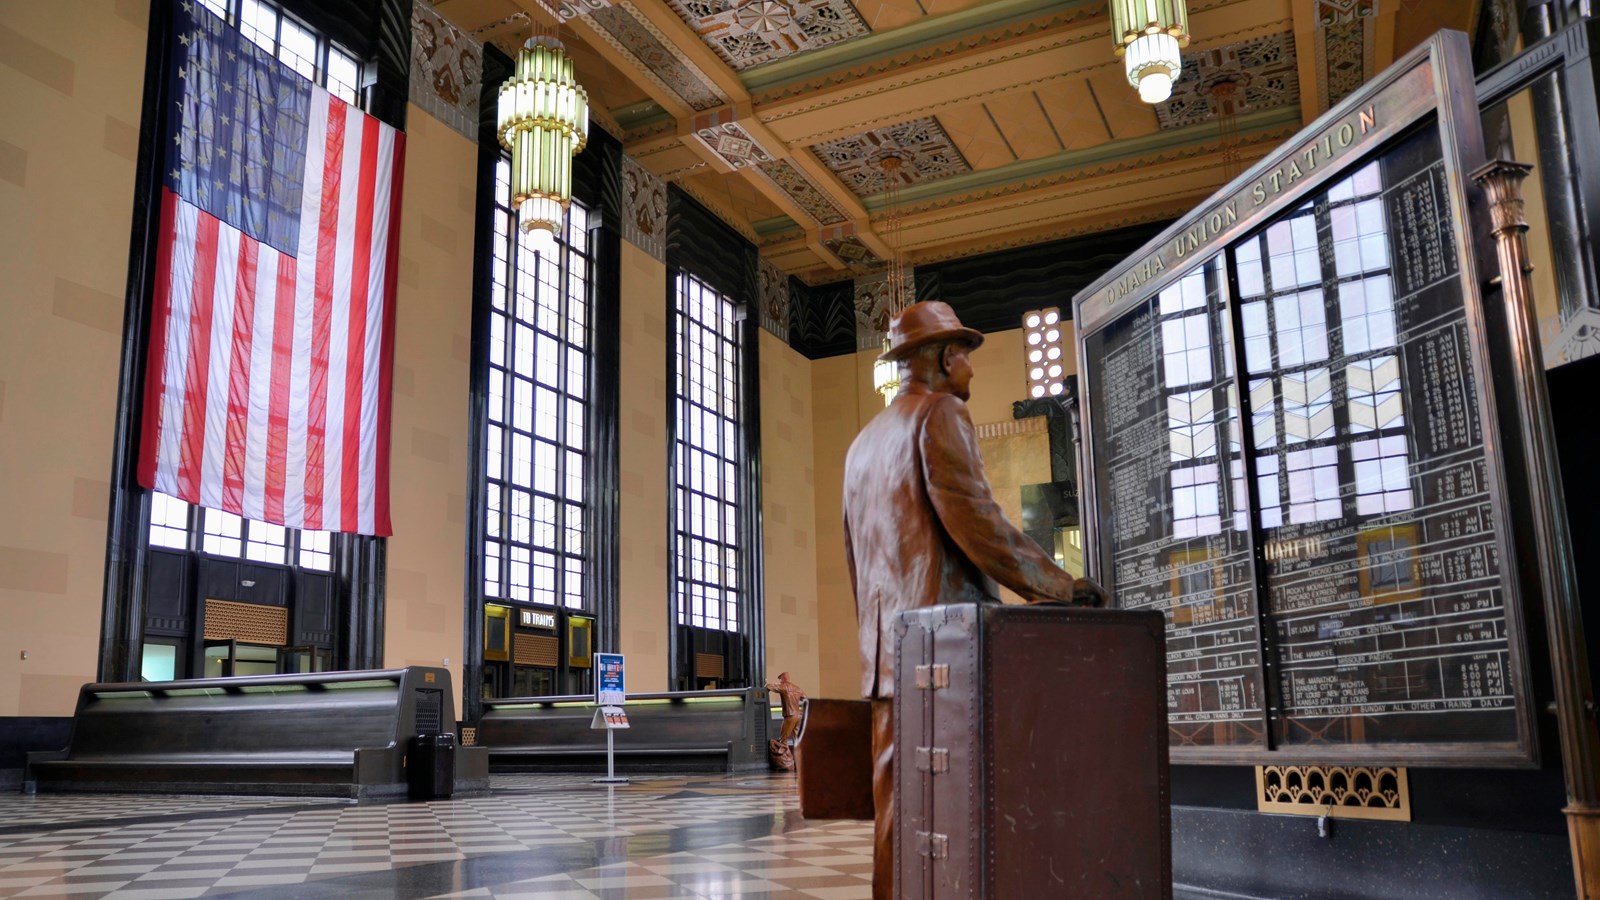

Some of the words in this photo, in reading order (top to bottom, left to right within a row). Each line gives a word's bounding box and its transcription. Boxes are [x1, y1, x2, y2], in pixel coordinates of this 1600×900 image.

[1105, 256, 1165, 305] OMAHA
[1175, 202, 1238, 258] UNION
[1252, 105, 1376, 206] STATION
[1439, 334, 1451, 344] AM
[1440, 341, 1453, 351] AM
[1441, 349, 1454, 359] AM
[1442, 357, 1455, 367] AM
[1443, 365, 1456, 375] AM
[1444, 372, 1457, 383] AM
[1446, 380, 1459, 390] AM
[1446, 388, 1460, 398] PM
[1448, 396, 1461, 406] PM
[1449, 404, 1462, 413] PM
[1450, 411, 1463, 421] PM
[1451, 419, 1464, 430] PM
[1453, 427, 1466, 437] PM
[1454, 435, 1467, 446] PM
[1460, 470, 1471, 480] AM
[1461, 479, 1472, 487] PM
[1462, 487, 1474, 496] PM
[1466, 516, 1477, 524] AM
[1466, 524, 1478, 533] PM
[1470, 552, 1482, 560] AM
[1430, 560, 1440, 568] AM
[1456, 564, 1466, 572] 30
[1471, 561, 1482, 569] PM
[1309, 566, 1332, 577] CHICAGO
[1334, 563, 1350, 572] ROCK
[1431, 568, 1441, 576] PM
[1457, 572, 1467, 580] 30
[1286, 586, 1305, 596] ROCKY
[1306, 581, 1335, 591] MOUNTAIN
[1336, 576, 1358, 586] LIMITED
[1287, 593, 1310, 602] CHICAGO
[1311, 588, 1337, 598] EXPRESS
[1315, 595, 1335, 605] STREET
[1338, 591, 1359, 600] LIMITED
[1461, 602, 1470, 610] 30
[1477, 599, 1489, 608] PM
[522, 612, 531, 624] TO
[532, 613, 554, 627] TRAINS
[1299, 625, 1315, 633] LOUIS
[1321, 621, 1343, 629] LIMITED
[1366, 624, 1394, 633] CENTRAL
[1464, 632, 1473, 640] 05
[1480, 631, 1492, 639] PM
[1469, 663, 1479, 671] 45
[1487, 670, 1499, 678] PM
[1341, 680, 1365, 689] WICHITA
[1471, 680, 1481, 688] 00
[1327, 689, 1338, 697] NEW
[1342, 687, 1369, 696] ORLEANS
[1489, 687, 1501, 695] PM
[1328, 706, 1353, 714] EXCEPT
[1360, 705, 1386, 713] SUNDAY
[1411, 702, 1436, 710] OTHER
[1443, 700, 1472, 709] TRAINS
